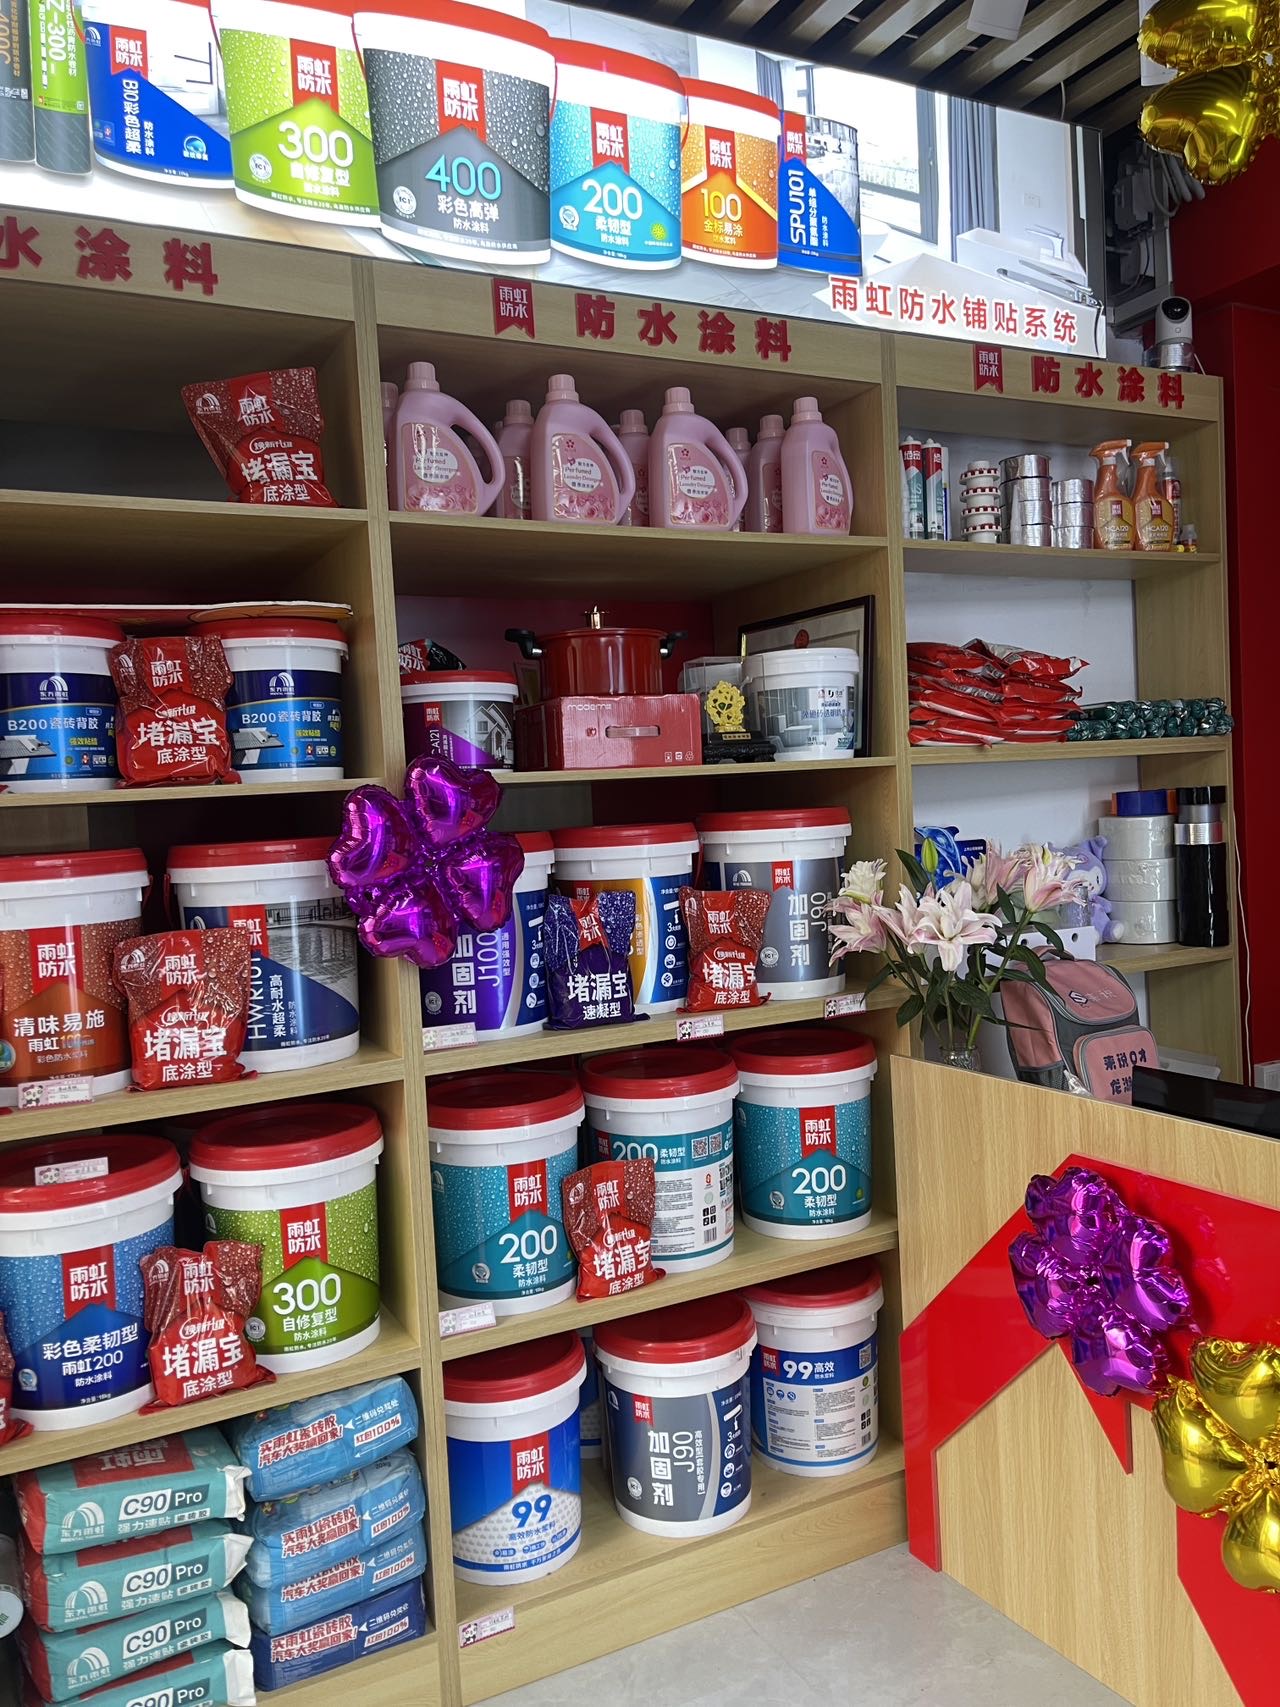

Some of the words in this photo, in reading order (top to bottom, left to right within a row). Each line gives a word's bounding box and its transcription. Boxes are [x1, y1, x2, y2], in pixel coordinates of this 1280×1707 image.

[115, 37, 142, 54] 雨虹
[116, 52, 142, 67] 防水
[297, 56, 331, 77] 雨虹
[298, 75, 332, 96] 防水
[443, 78, 477, 102] 雨虹
[443, 99, 478, 121] 防水
[596, 122, 623, 141] 雨虹
[786, 131, 803, 145] 雨虹
[278, 121, 353, 168] 300
[596, 139, 624, 158] 防水
[709, 139, 731, 156] 雨虹
[786, 142, 803, 154] 防水
[709, 153, 732, 169] 防水
[425, 154, 501, 199] 400
[438, 195, 499, 221] 彩色高弹
[581, 178, 642, 220] 200
[701, 188, 742, 221] 100
[788, 169, 806, 245] SPU101
[453, 219, 489, 234] 防水涂料
[703, 220, 743, 237] 金标易涂
[499, 286, 528, 303] 雨虹
[500, 301, 529, 318] 防水
[829, 276, 1077, 345] 雨虹防水铺贴系统
[575, 292, 792, 362] 防水涂料
[978, 350, 999, 365] 雨虹
[978, 362, 999, 378] 防水
[1031, 354, 1184, 410] 防水涂料
[238, 395, 269, 415] 雨虹
[242, 410, 275, 427] 防水
[241, 450, 318, 485] 堵漏宝
[263, 484, 310, 502] 底涂型
[150, 660, 181, 676] 雨虹
[152, 672, 183, 688] 防水
[8, 719, 47, 731] B200
[50, 717, 99, 730] 瓷砖背胶
[242, 712, 276, 724] B200
[278, 710, 321, 722] 瓷砖背胶
[137, 717, 220, 746] 堵漏宝
[157, 746, 208, 765] 底涂型
[774, 867, 791, 876] 雨虹
[775, 876, 791, 884] 防水
[708, 910, 730, 924] 雨虹
[811, 892, 827, 932] J90
[709, 922, 732, 934] 防水
[788, 893, 810, 967] 加固剂
[37, 943, 75, 961] 雨虹
[477, 932, 500, 987] J100
[37, 959, 76, 978] 防水
[165, 954, 196, 972] 雨虹
[166, 969, 198, 986] 防水
[567, 971, 628, 1003] 堵漏宝
[269, 974, 286, 1038] 高耐水超柔
[714, 991, 750, 1005] 底涂型
[288, 1001, 298, 1036] 防水涂料
[583, 1001, 622, 1021] 速凝型
[13, 1009, 105, 1038] 清味易施
[28, 1037, 59, 1053] 雨虹
[144, 1025, 226, 1062] 堵漏宝
[162, 1062, 212, 1082] 底涂型
[805, 1119, 831, 1132] 雨虹
[805, 1130, 831, 1145] 防水
[613, 1141, 658, 1164] 200
[660, 1147, 686, 1158] 柔韧型
[514, 1174, 542, 1191] 雨虹
[596, 1180, 618, 1196] 雨虹
[792, 1165, 846, 1195] 200
[514, 1188, 543, 1207] 防水
[597, 1193, 620, 1211] 防水
[804, 1193, 837, 1208] 柔韧型
[809, 1207, 835, 1217] 防水涂料
[287, 1218, 320, 1239] 雨虹
[288, 1235, 321, 1255] 防水
[499, 1225, 557, 1264] 200
[184, 1258, 213, 1278] 雨虹
[513, 1258, 548, 1278] 柔韧型
[593, 1239, 651, 1281] 堵漏宝
[69, 1262, 108, 1285] 雨虹
[518, 1274, 546, 1288] 防水涂料
[70, 1279, 108, 1302] 防水
[184, 1275, 214, 1295] 防水
[273, 1273, 341, 1315] 300
[609, 1273, 644, 1295] 底涂型
[283, 1306, 338, 1332] 自修复型
[42, 1322, 139, 1361] 彩色柔韧型
[294, 1327, 327, 1342] 防水涂料
[162, 1333, 243, 1379] 堵漏宝
[75, 1371, 113, 1388] 防水涂料
[783, 1360, 813, 1379] 99
[814, 1361, 834, 1373] 高效
[182, 1370, 234, 1399] 底涂型
[635, 1401, 650, 1411] 雨虹
[635, 1409, 650, 1419] 防水
[260, 1414, 336, 1455] 买雨虹瓷砖胶
[516, 1445, 544, 1466] 雨虹
[673, 1431, 694, 1473] J90
[517, 1463, 545, 1481] 防水
[648, 1430, 674, 1507] 加固剂
[124, 1493, 168, 1516] C90
[175, 1491, 203, 1507] Pro
[512, 1494, 552, 1528] 99
[117, 1516, 171, 1534] 强力速贴
[282, 1506, 356, 1545] 买雨虹瓷砖胶
[126, 1567, 169, 1592] C90
[176, 1563, 203, 1580] Pro
[121, 1590, 174, 1610] 强力速贴
[126, 1625, 168, 1654] C90
[175, 1617, 201, 1634] Pro
[272, 1614, 352, 1650] 买雨虹瓷砖胶
[123, 1645, 175, 1671] 强力速贴
[177, 1687, 204, 1703] Pro
